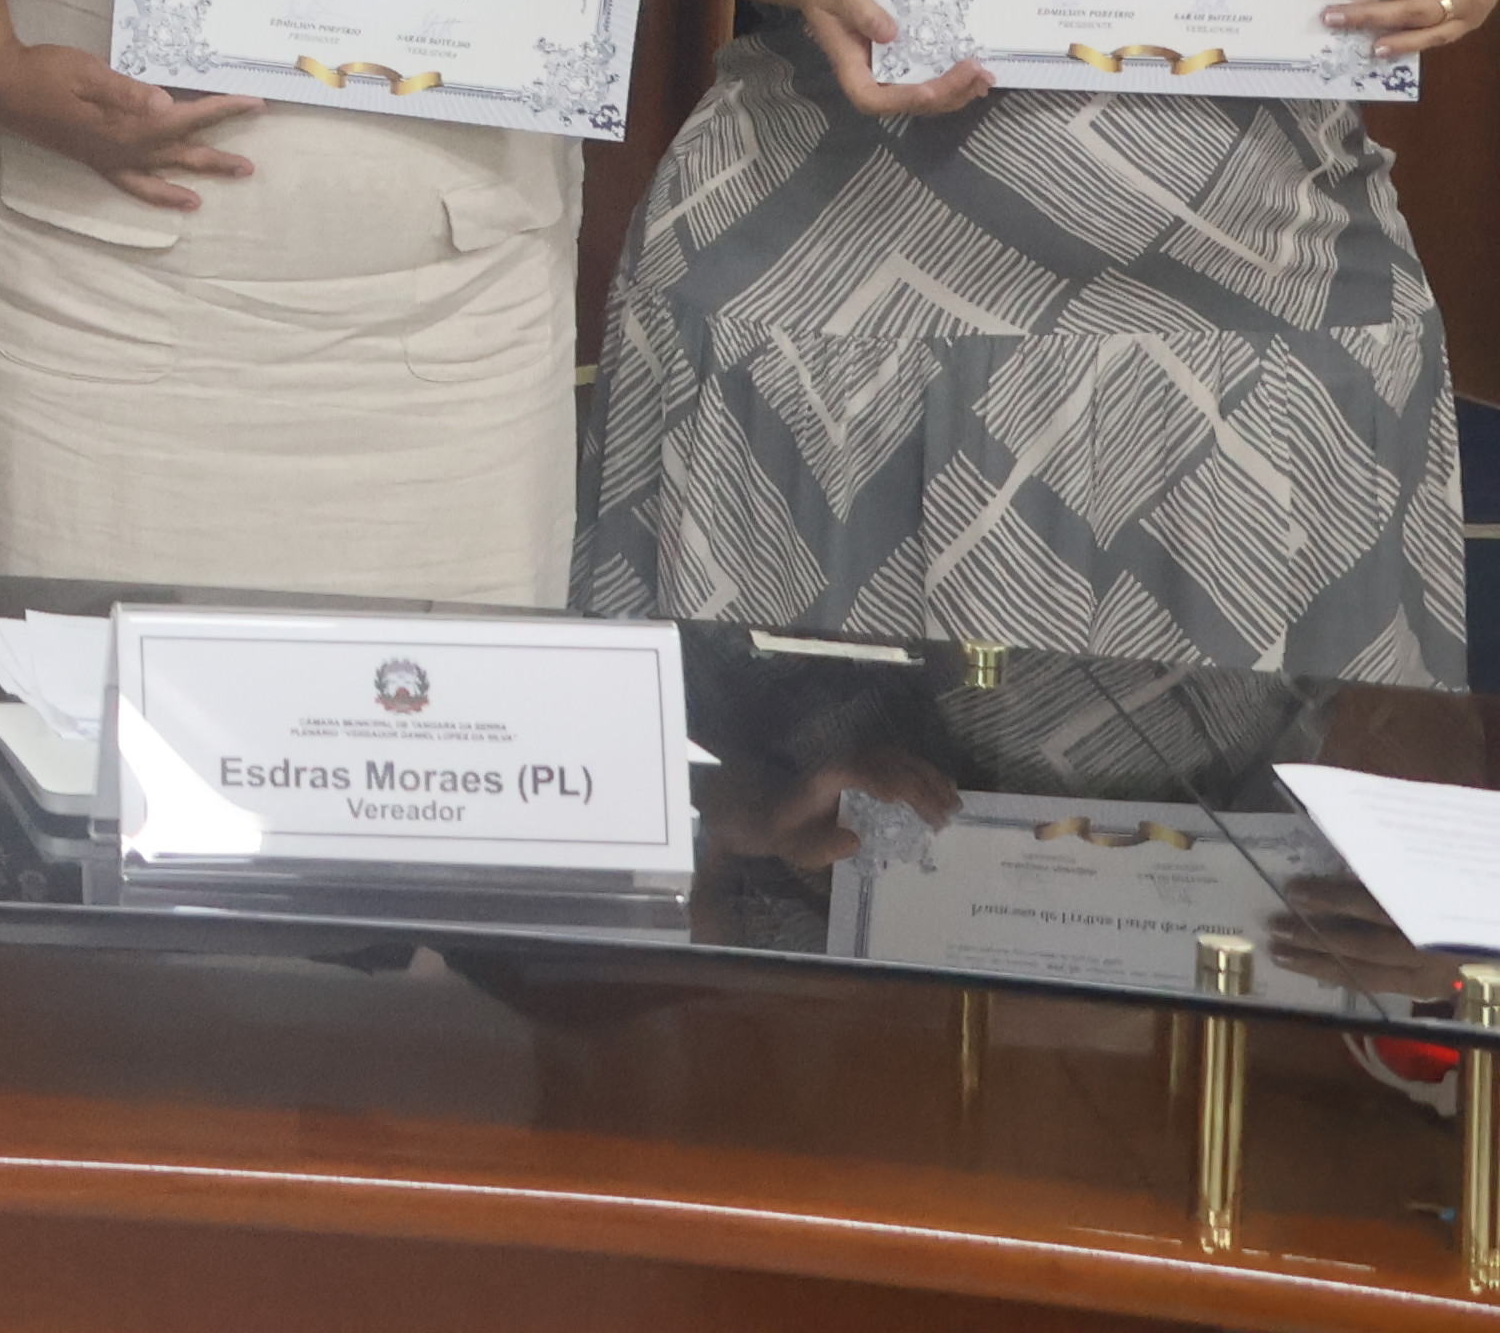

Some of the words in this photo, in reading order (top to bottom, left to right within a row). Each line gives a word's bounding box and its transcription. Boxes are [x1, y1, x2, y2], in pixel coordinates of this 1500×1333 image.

[219, 755, 351, 792] Esdras
[365, 760, 504, 796] Moraes
[517, 765, 594, 805] (PL)
[347, 796, 467, 824] Vereador
